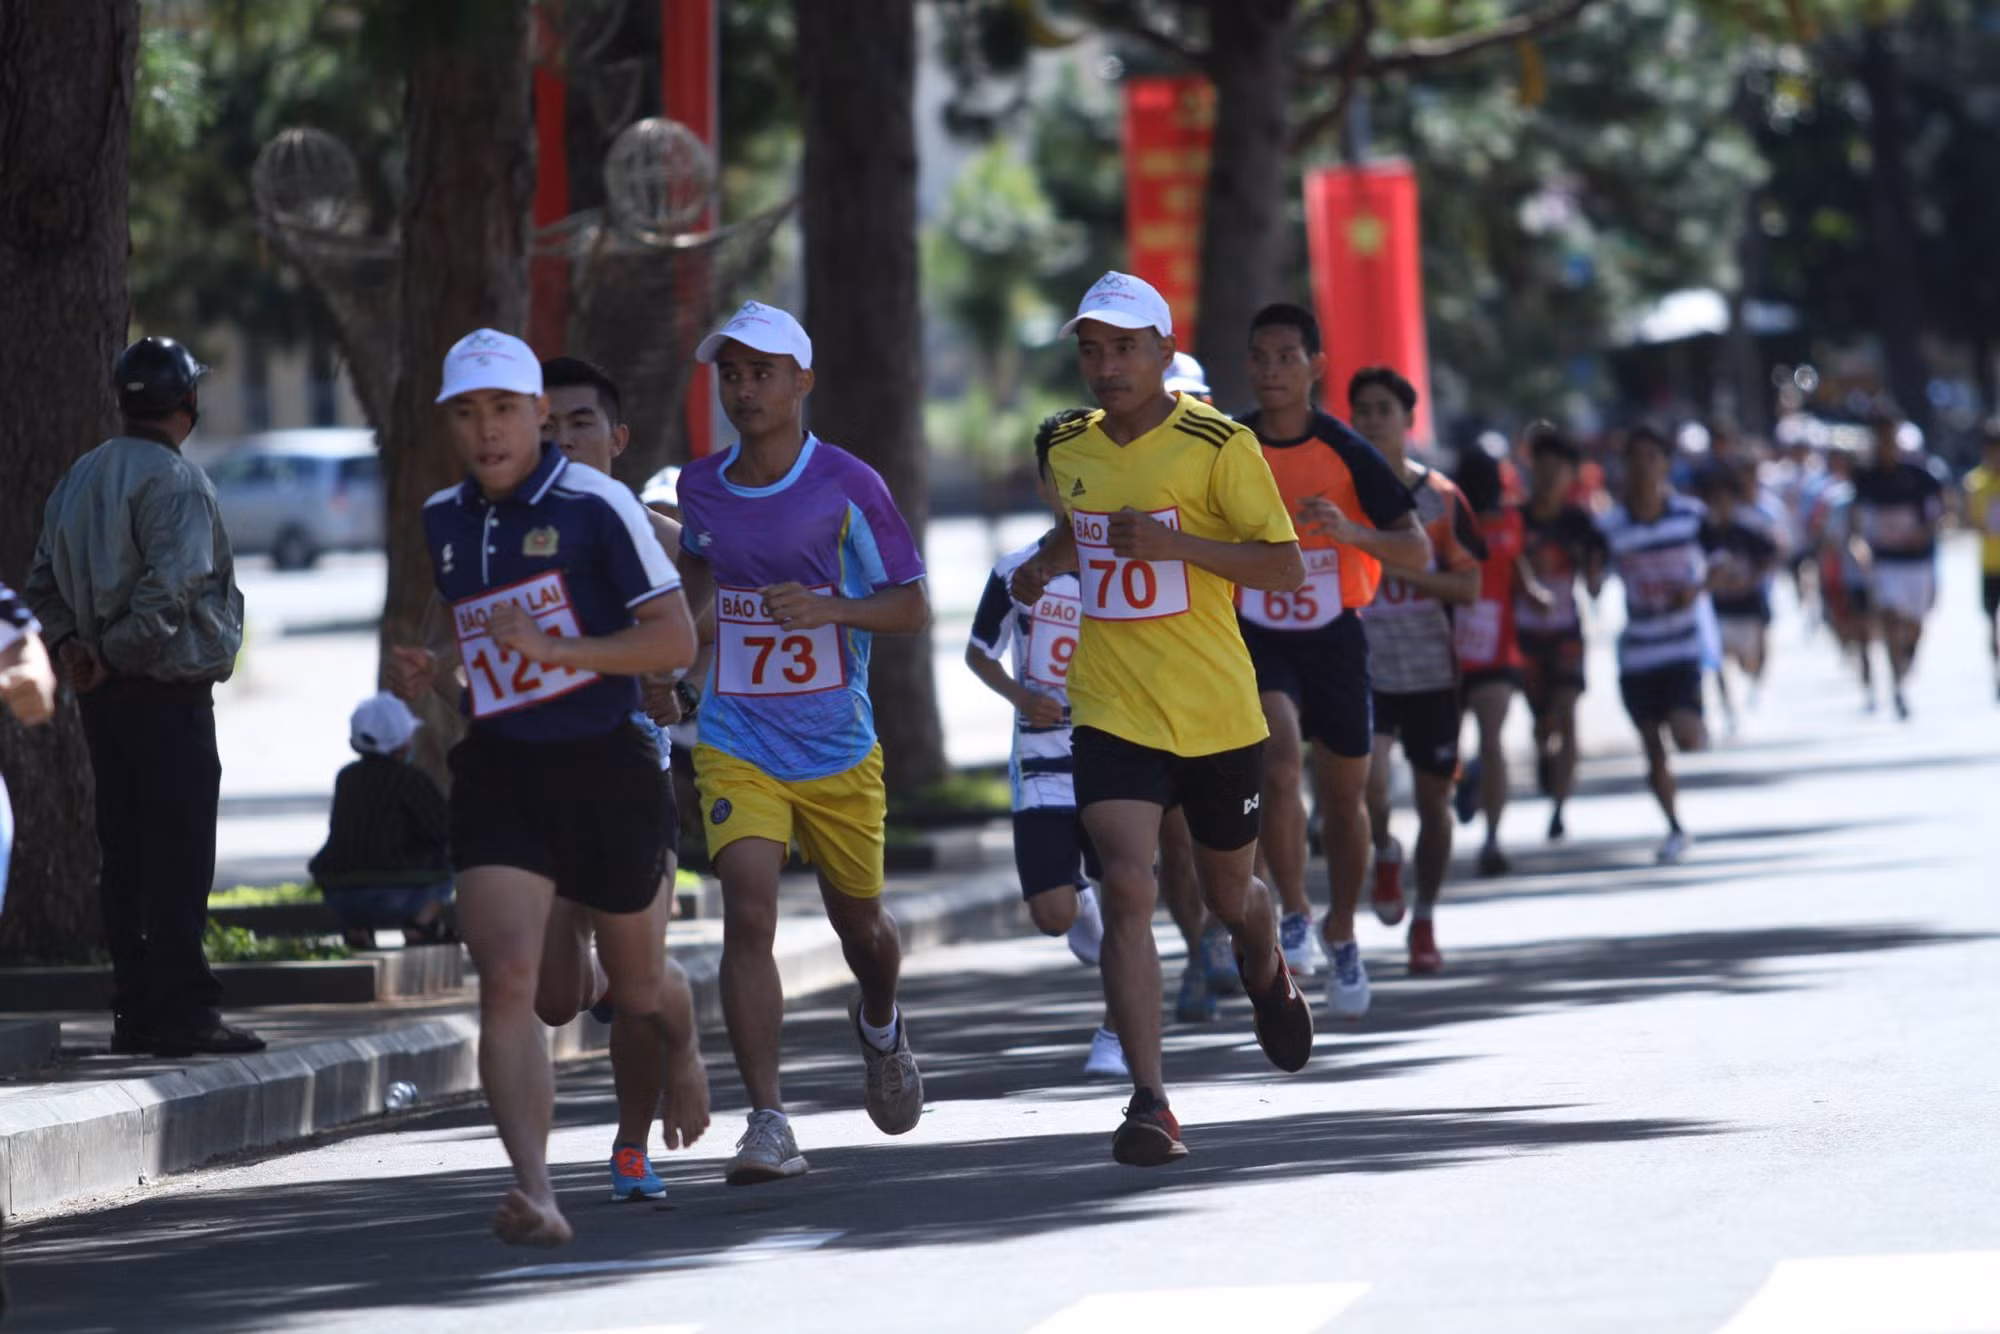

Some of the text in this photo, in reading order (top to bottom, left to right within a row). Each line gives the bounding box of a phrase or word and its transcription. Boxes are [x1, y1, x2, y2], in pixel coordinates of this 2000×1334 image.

[1076, 516, 1102, 541] BÁO
[1088, 559, 1157, 610] 70
[1264, 584, 1318, 622] 65
[458, 606, 489, 632] BÁO
[525, 584, 562, 611] LAI
[722, 594, 755, 618] BÁO
[1041, 601, 1076, 621] BÁO
[743, 635, 817, 685] 73
